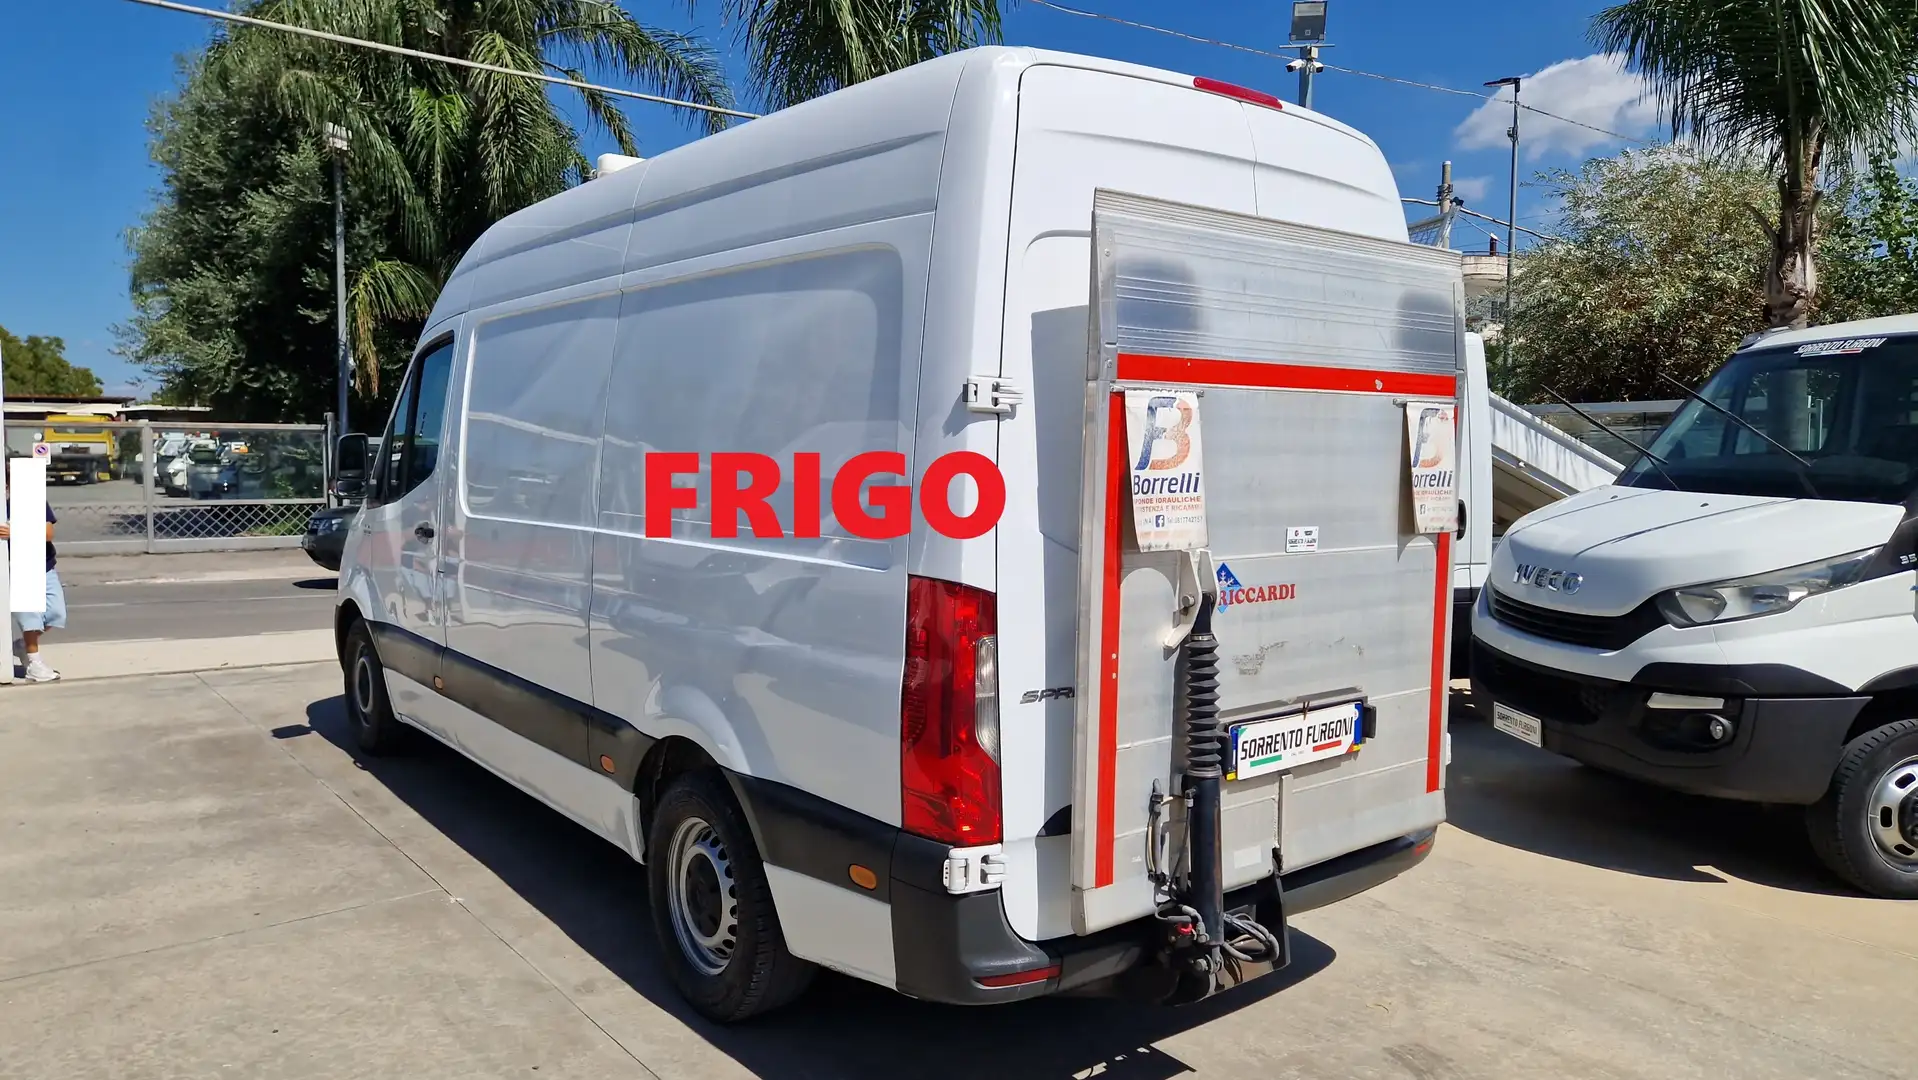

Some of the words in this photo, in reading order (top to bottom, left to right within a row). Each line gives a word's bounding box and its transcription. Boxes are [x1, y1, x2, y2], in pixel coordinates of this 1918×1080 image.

[1133, 472, 1200, 495] Borrelli
[1413, 471, 1453, 488] orrelli
[1513, 564, 1583, 595] IVECO
[1218, 583, 1296, 606] RICCARDI
[1240, 727, 1303, 760] SORRENTO
[1306, 716, 1353, 745] FURGONI
